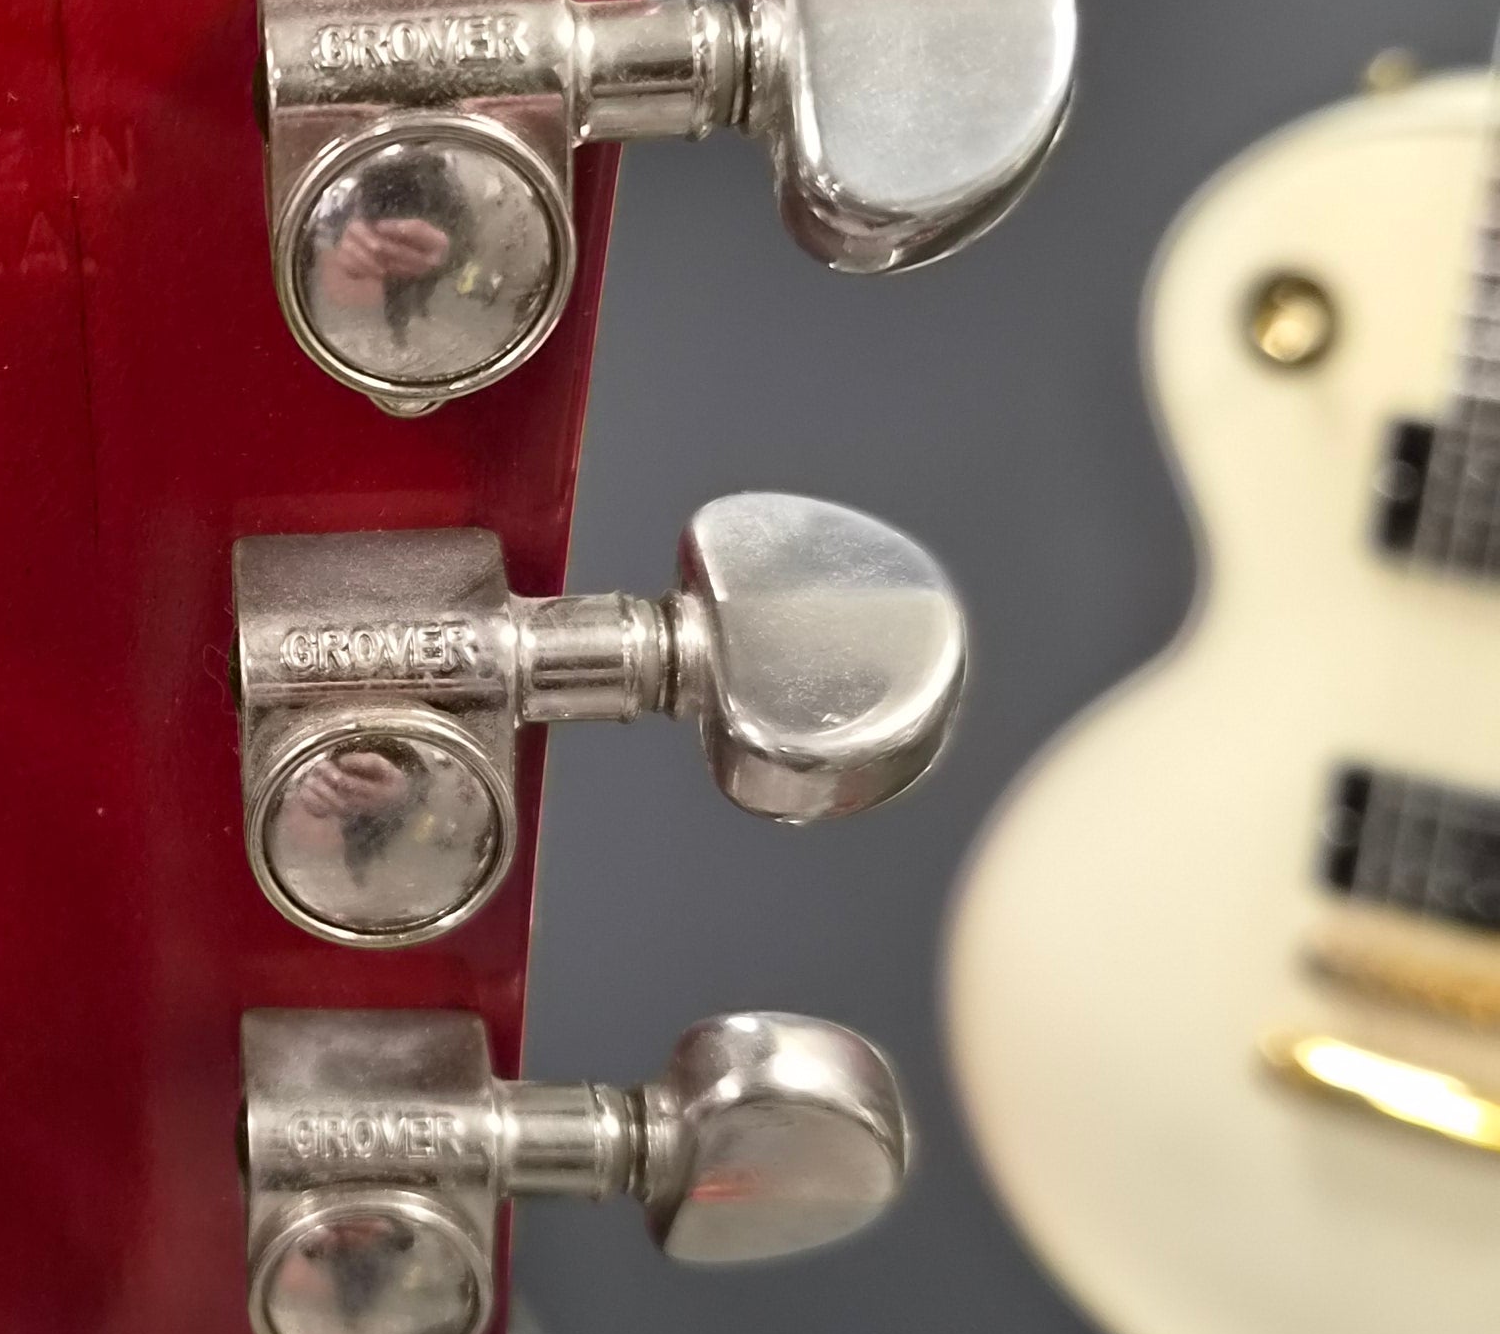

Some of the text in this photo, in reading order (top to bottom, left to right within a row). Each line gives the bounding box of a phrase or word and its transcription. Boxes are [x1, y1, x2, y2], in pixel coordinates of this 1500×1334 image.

[310, 16, 531, 70] GROVER
[63, 120, 140, 193] IN
[279, 620, 478, 676] GROVER
[286, 1108, 466, 1162] GROVER
